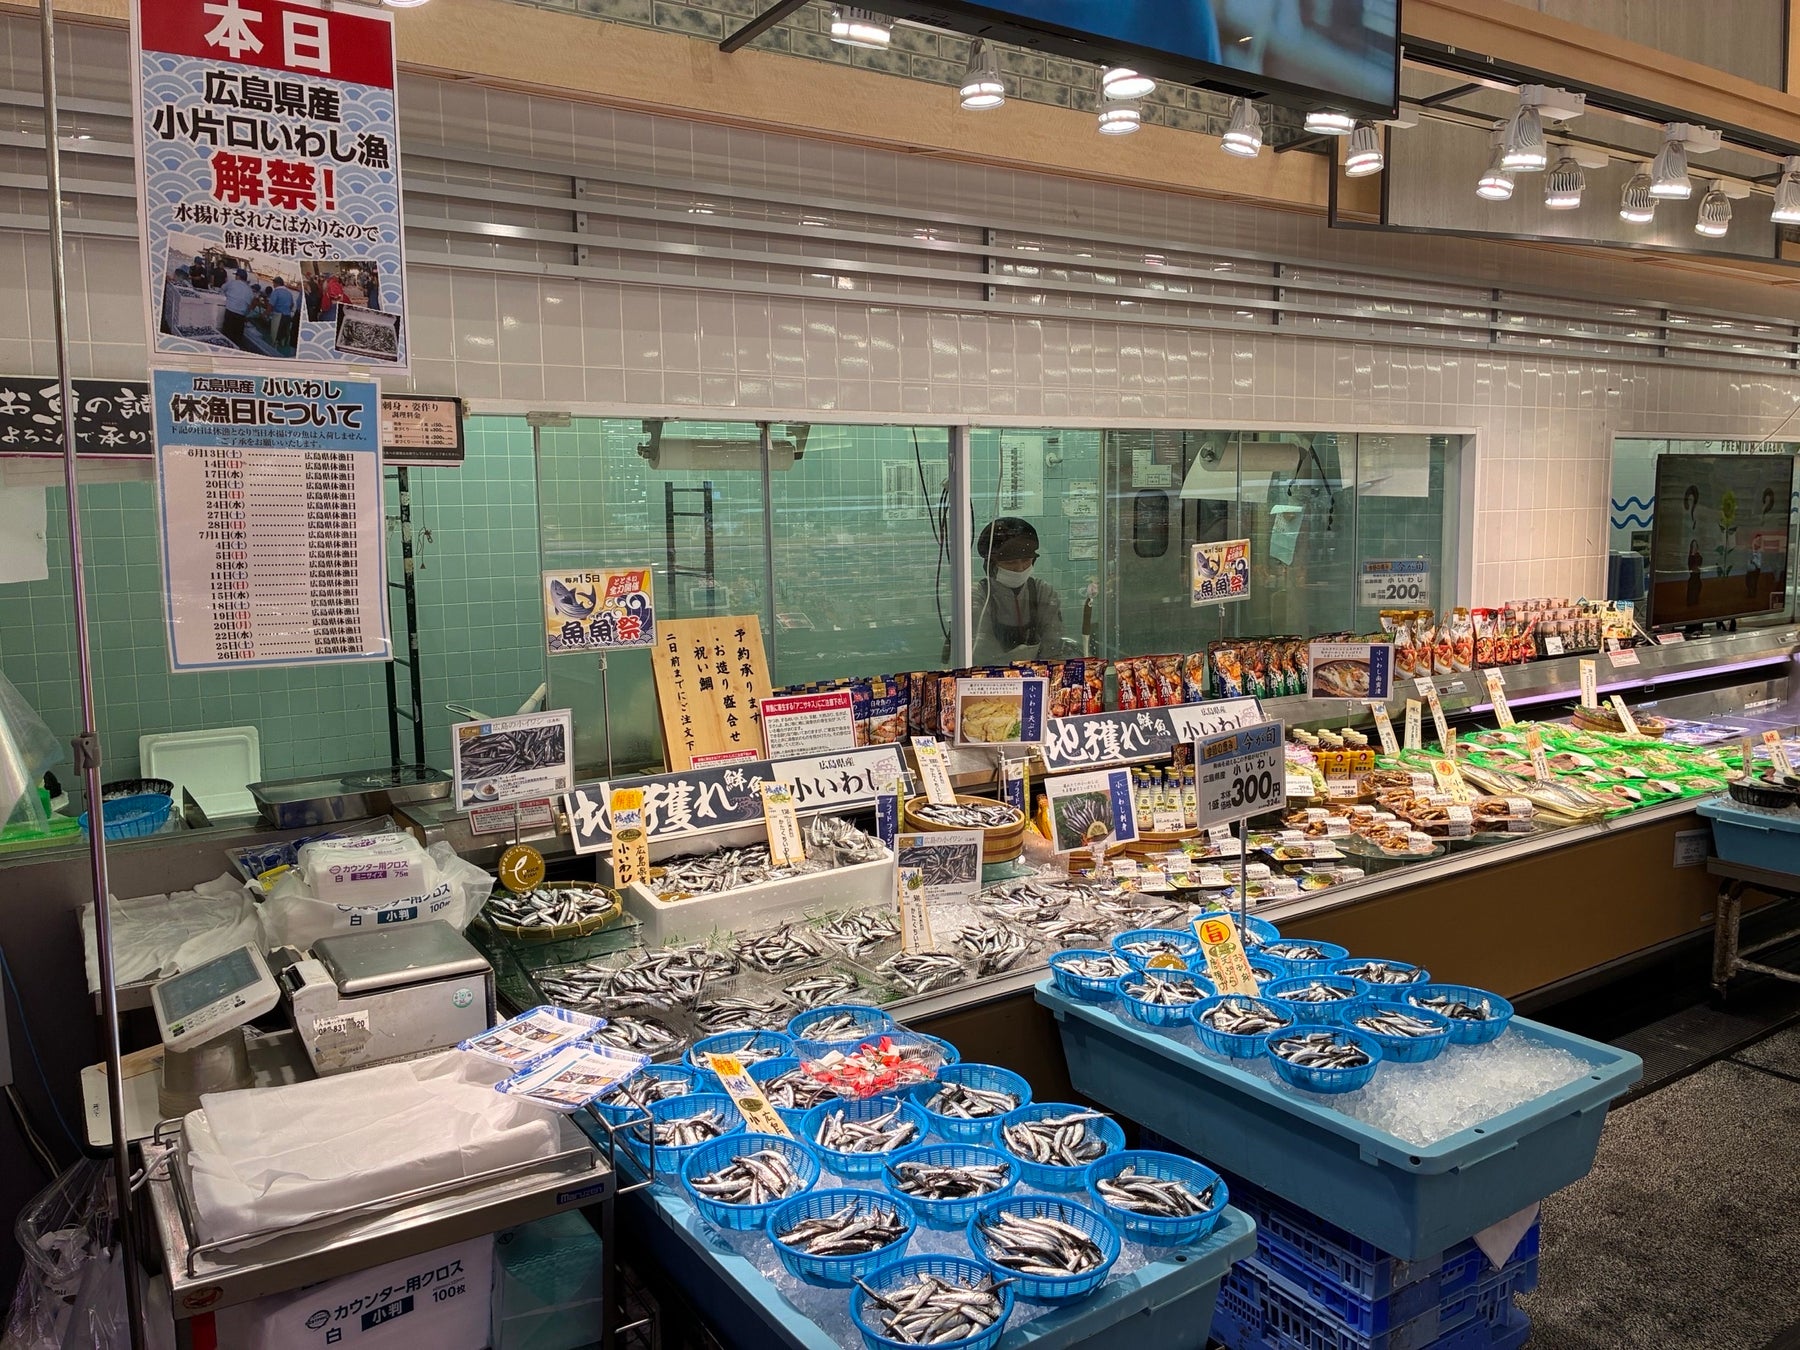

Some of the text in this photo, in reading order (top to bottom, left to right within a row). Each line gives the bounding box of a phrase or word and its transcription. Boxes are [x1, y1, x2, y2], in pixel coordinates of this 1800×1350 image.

[204, 0, 331, 73] 本日
[204, 71, 341, 123] 広島県産
[153, 105, 390, 169] 小片口いわし漁
[211, 151, 336, 211] 解禁!
[174, 203, 379, 242] 水揚げされたばかりなので
[224, 230, 340, 260] 鮮度抜群です。
[193, 377, 341, 399] 広島県産 小いわし
[171, 394, 363, 429] 休漁日について
[561, 615, 642, 646] 魚魚祭
[734, 629, 761, 724] 予約承ります
[1028, 685, 1037, 737] 小いわし天ぷら
[1137, 712, 1171, 737] 鮮魚
[1047, 718, 1151, 762] 地獲れ
[1243, 727, 1276, 750] 今が旬
[819, 757, 855, 770] 広島県産
[1233, 756, 1276, 776] 小いわし
[790, 767, 880, 802] 小いわし
[335, 875, 344, 883] 白
[343, 860, 408, 873] カウンター用クロス
[618, 843, 633, 884] 小いわし
[350, 914, 362, 926] 白
[386, 911, 410, 922] 小判
[334, 1259, 464, 1322] カウンター用クロス
[326, 1284, 466, 1344] 白 小判 100枚
